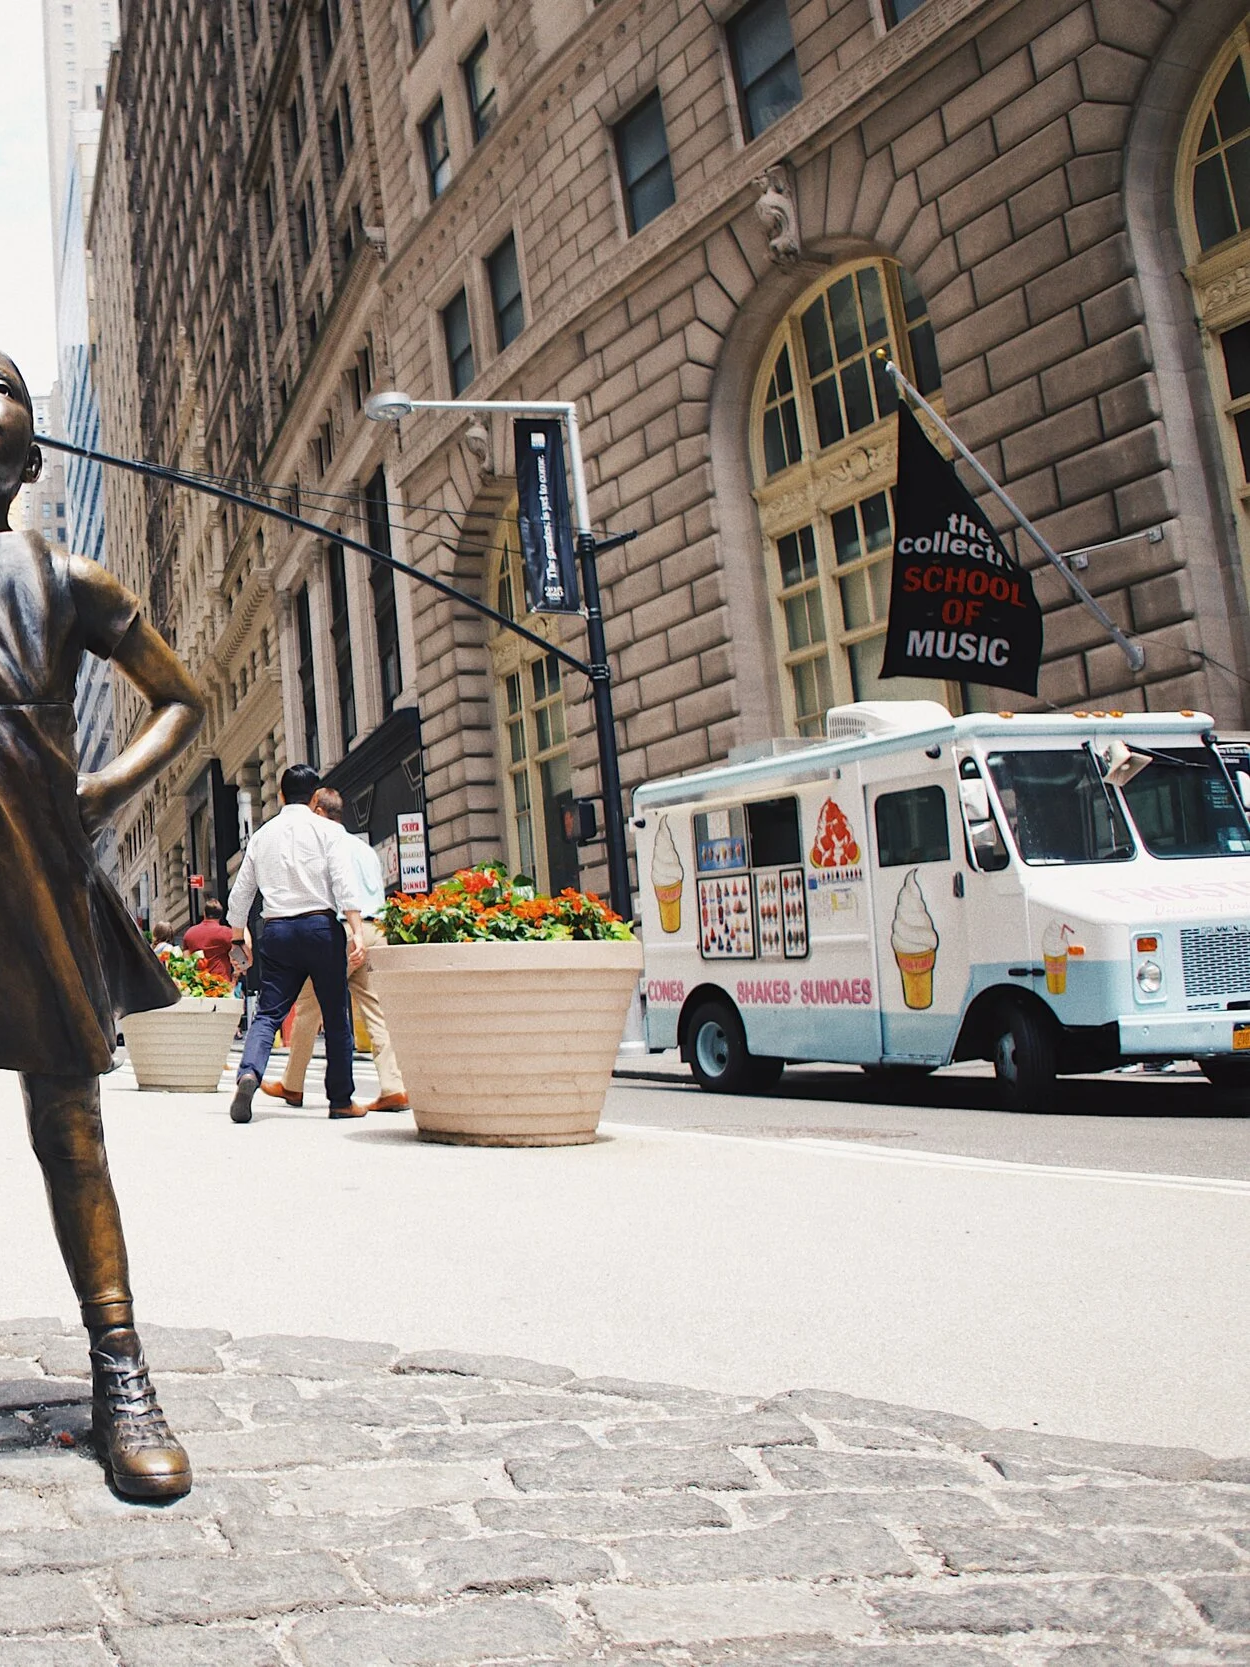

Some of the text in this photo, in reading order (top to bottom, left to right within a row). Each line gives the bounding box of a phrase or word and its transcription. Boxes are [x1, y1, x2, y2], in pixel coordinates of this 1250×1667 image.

[538, 484, 548, 495] to
[539, 496, 553, 512] yet
[541, 511, 551, 521] is
[948, 512, 992, 543] the
[898, 531, 1013, 571] collecti
[546, 560, 558, 580] The
[902, 565, 1027, 609] SCHOOL
[941, 598, 984, 626] OF
[906, 630, 1010, 667] MUSIC
[402, 865, 425, 875] LUNCH
[403, 880, 426, 891] DINNER
[647, 979, 685, 1002] CONES
[736, 977, 873, 1005] SHAKES SUNDAES
